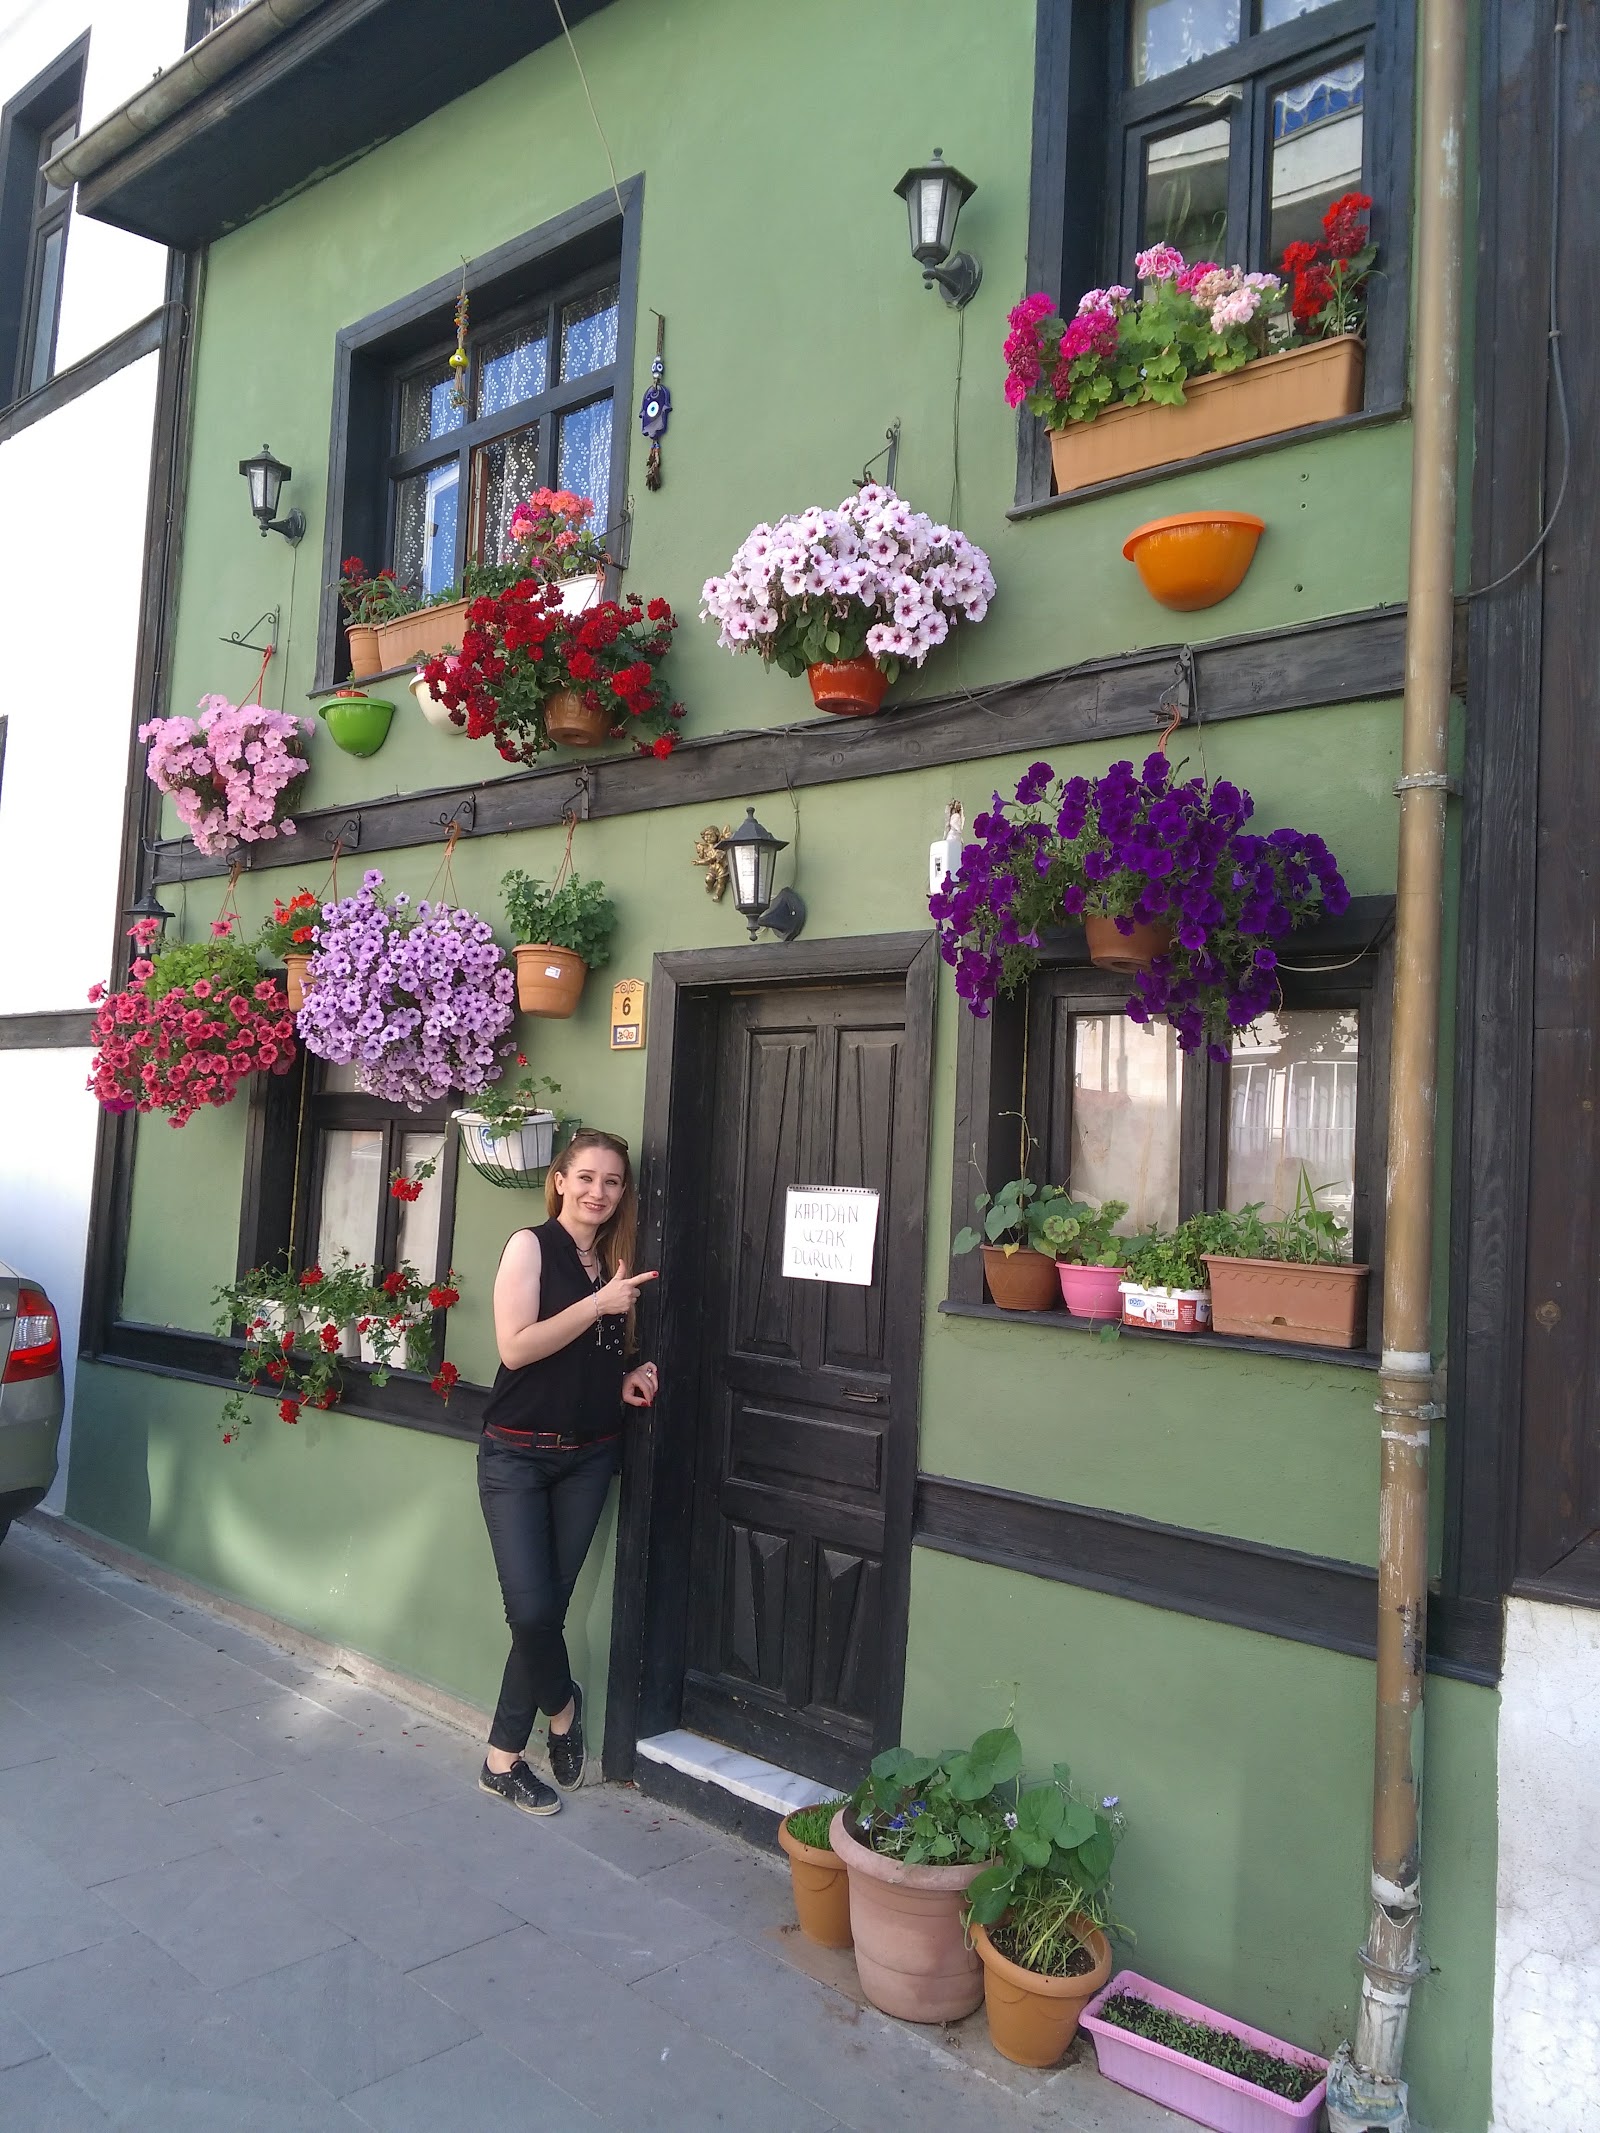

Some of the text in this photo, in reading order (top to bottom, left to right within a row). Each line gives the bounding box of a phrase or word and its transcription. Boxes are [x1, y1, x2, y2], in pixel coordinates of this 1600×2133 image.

[623, 997, 631, 1016] 6
[795, 1203, 859, 1223] KAPIDAN
[803, 1229, 846, 1247] UZAK
